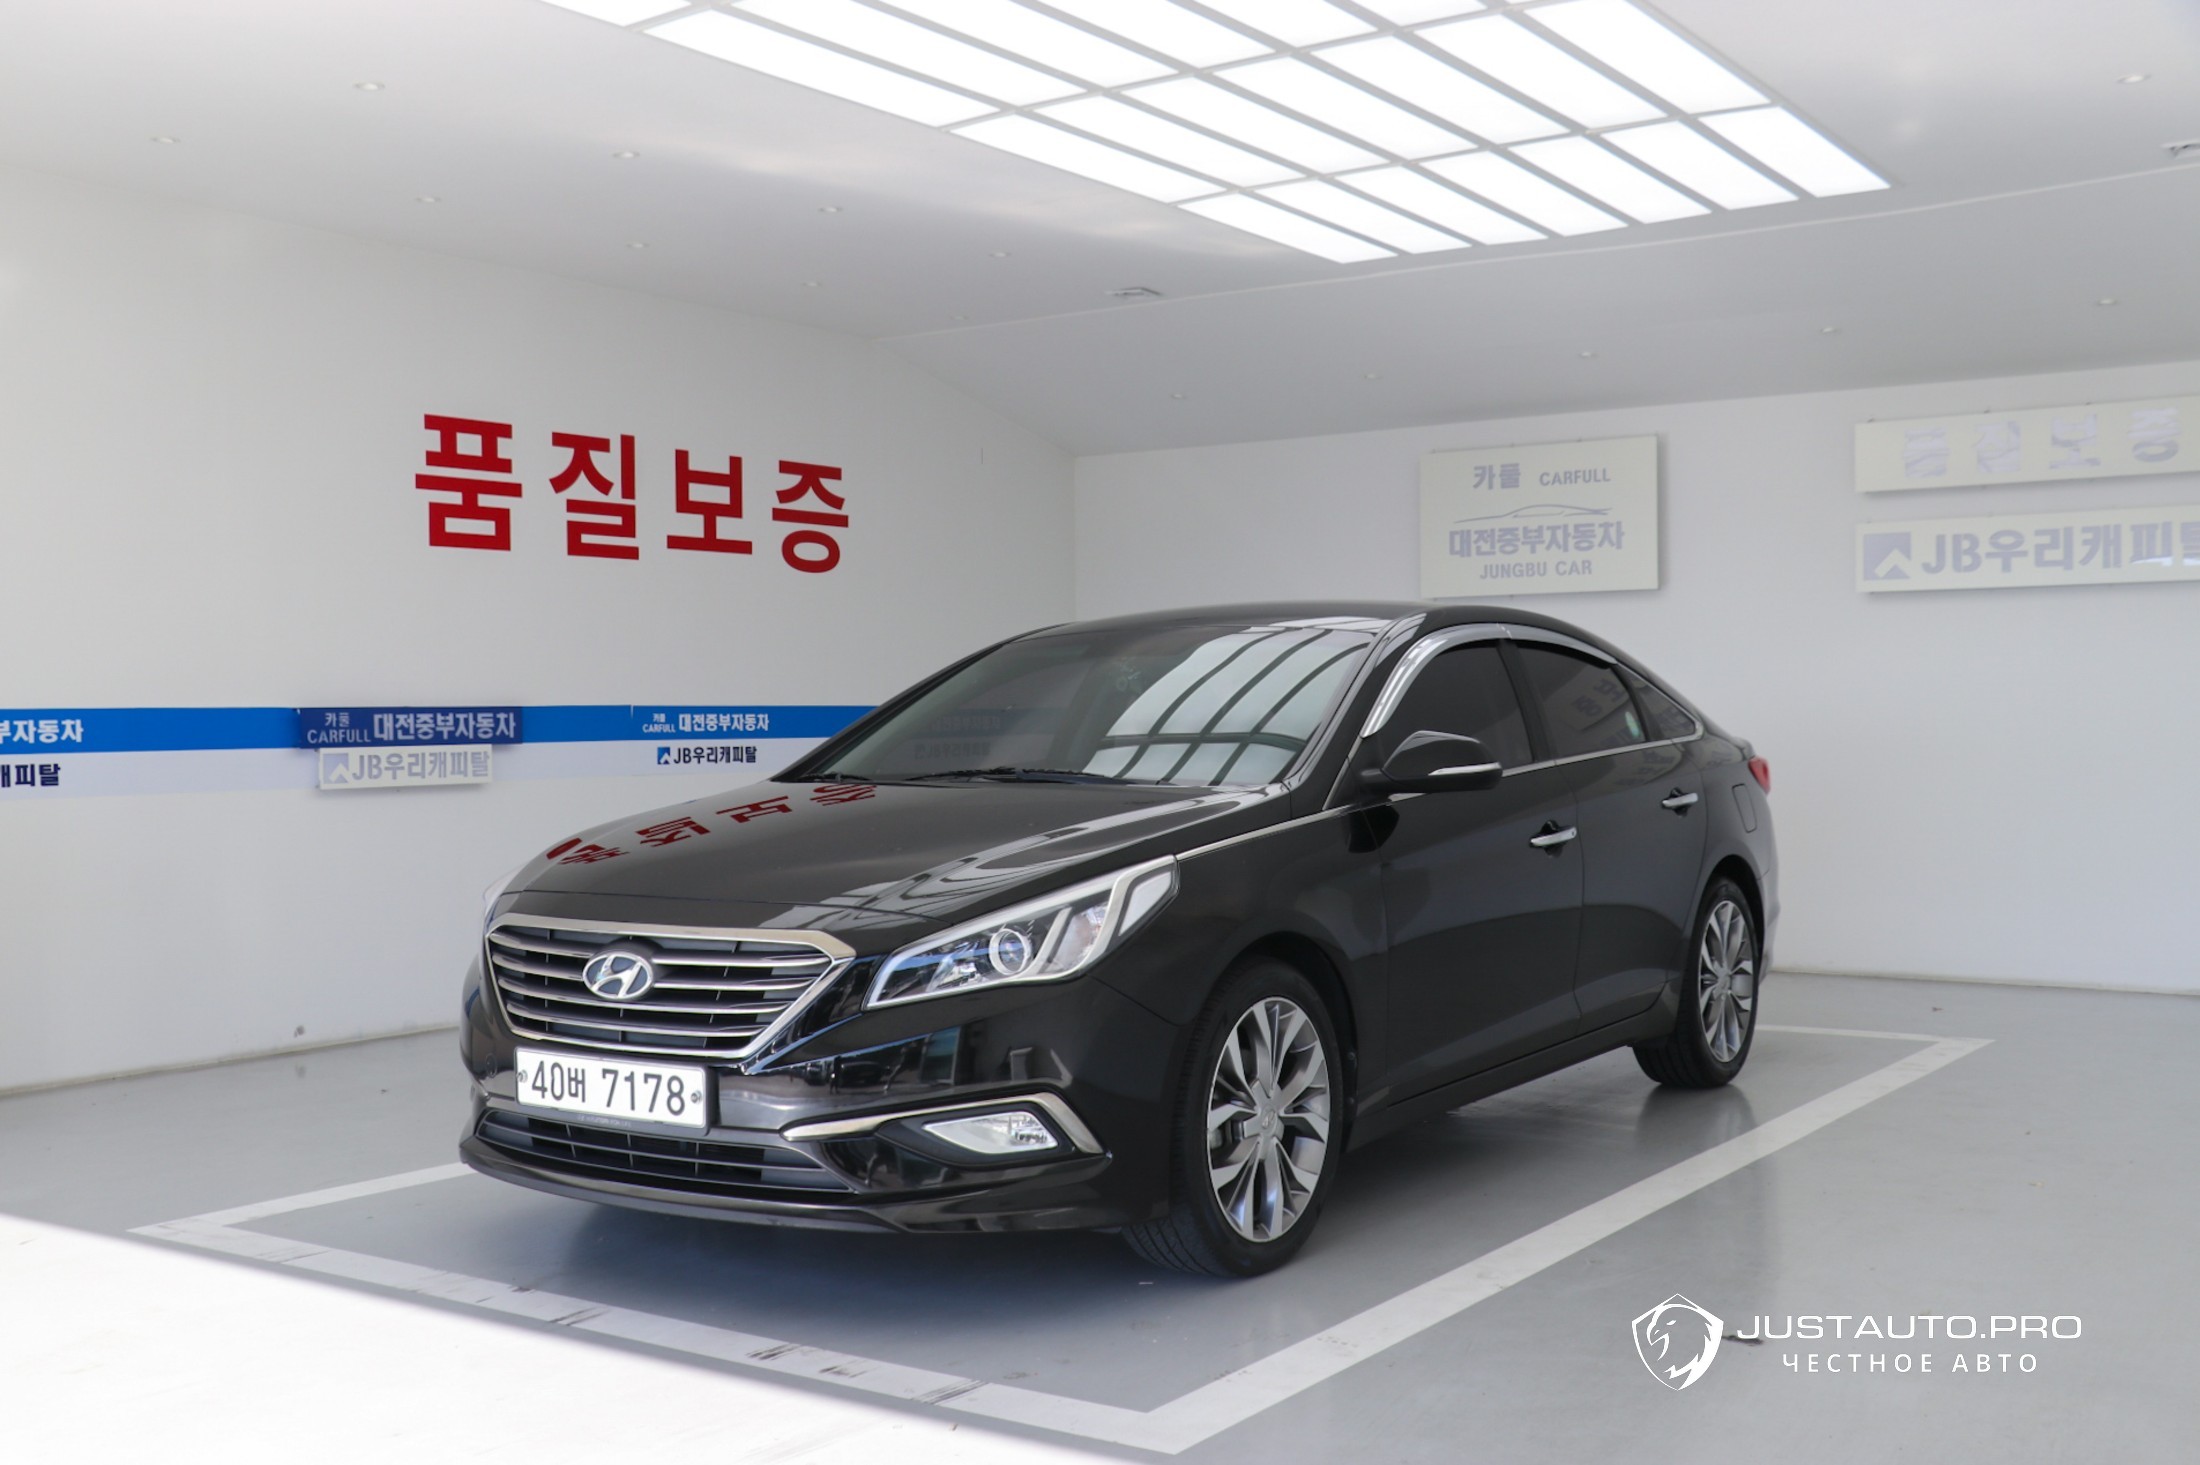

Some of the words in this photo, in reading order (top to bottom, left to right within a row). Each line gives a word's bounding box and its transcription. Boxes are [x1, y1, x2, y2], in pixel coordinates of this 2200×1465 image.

[1539, 468, 1611, 486] CARFULL
[415, 414, 849, 573] 품질보증
[1449, 521, 1625, 558] 대전중부자동차
[1480, 562, 1547, 580] JUNGBU
[1555, 560, 1592, 576] CAR
[373, 712, 516, 741] 대전중부자동차
[642, 723, 676, 733] CARFULL
[678, 713, 770, 732] 대전중부자동차
[307, 729, 371, 743] CARFULL
[352, 751, 489, 780] JB우리캐피탈
[673, 747, 757, 764] JB우리캐피탈
[532, 1060, 585, 1103] 40버
[602, 1068, 685, 1116] 7178
